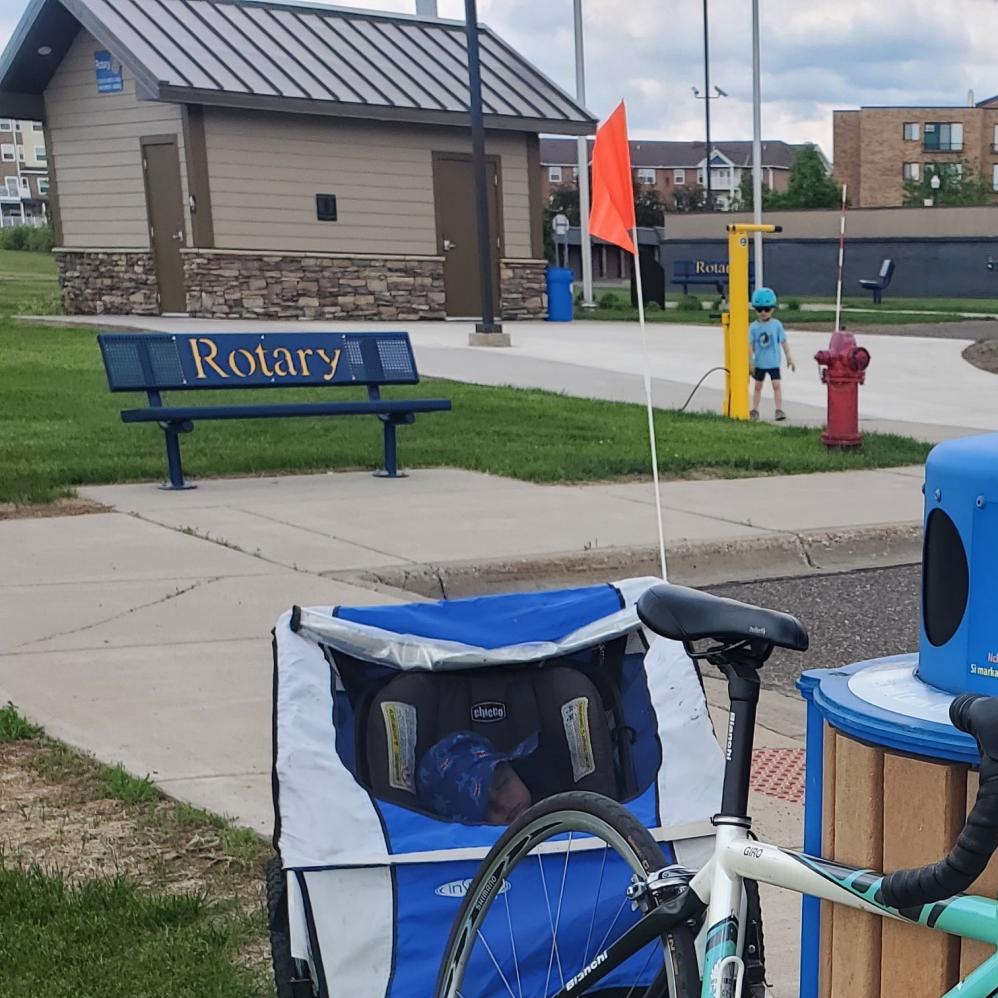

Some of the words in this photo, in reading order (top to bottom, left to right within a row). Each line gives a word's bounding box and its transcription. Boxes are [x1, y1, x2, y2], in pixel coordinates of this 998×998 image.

[695, 260, 730, 274] Rota
[188, 337, 341, 381] Rotary
[970, 663, 977, 674] Si
[743, 846, 764, 859] GIRO
